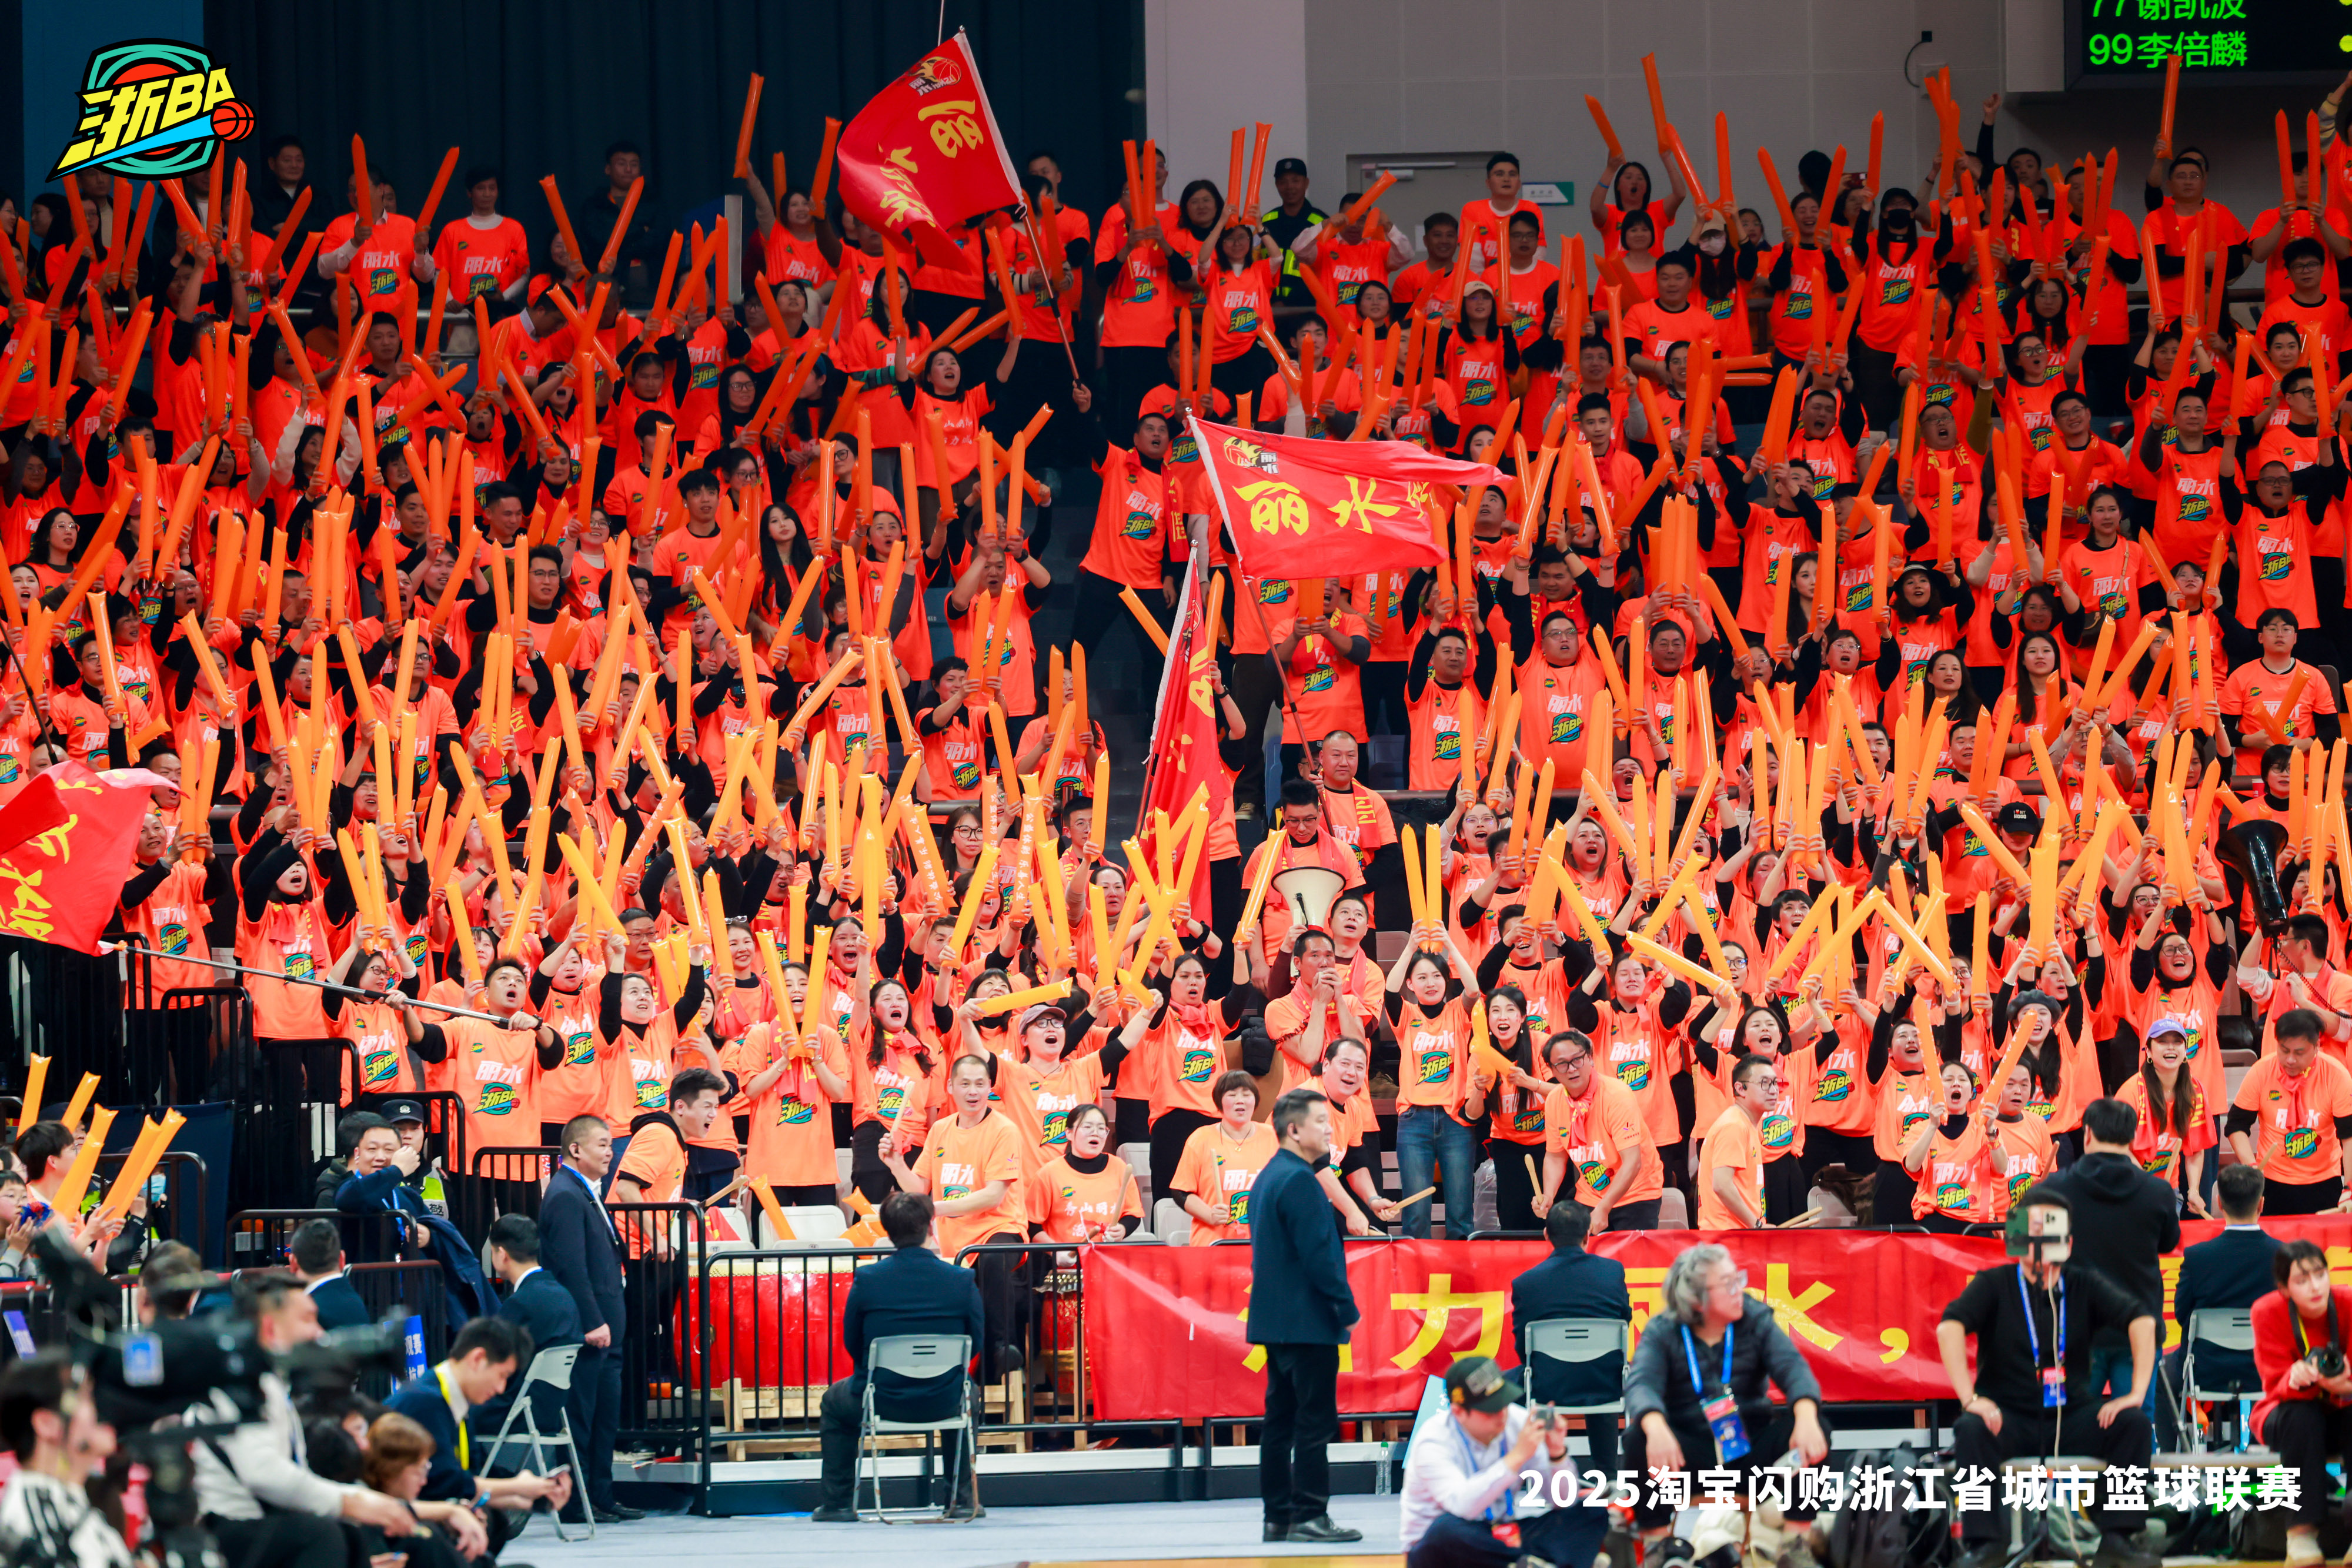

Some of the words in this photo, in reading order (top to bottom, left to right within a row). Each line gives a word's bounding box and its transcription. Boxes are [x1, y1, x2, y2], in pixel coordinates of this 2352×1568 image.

[363, 251, 400, 268] 丽水
[465, 258, 502, 273] 丽水
[1224, 292, 1258, 307] 丽水
[1460, 361, 1495, 378] 丽水
[2177, 479, 2215, 495] 丽水
[2258, 536, 2293, 553] 丽水
[1547, 694, 1582, 716] 丽水
[1551, 717, 1584, 742] 浙BA
[944, 741, 977, 761] 丽水
[152, 903, 188, 927] 丽水
[1412, 1030, 1455, 1051] 丽水
[1609, 1038, 1651, 1061] 丽水
[365, 1050, 399, 1085] 浙BA
[475, 1060, 523, 1083] 丽水
[1177, 1057, 1215, 1082] 浙BA
[1415, 1055, 1452, 1085] 浙BA
[1813, 1074, 1852, 1102] 浙BA
[473, 1089, 517, 1114] 浙BA
[2284, 1130, 2318, 1158] 浙BA
[940, 1163, 974, 1185] 丽水
